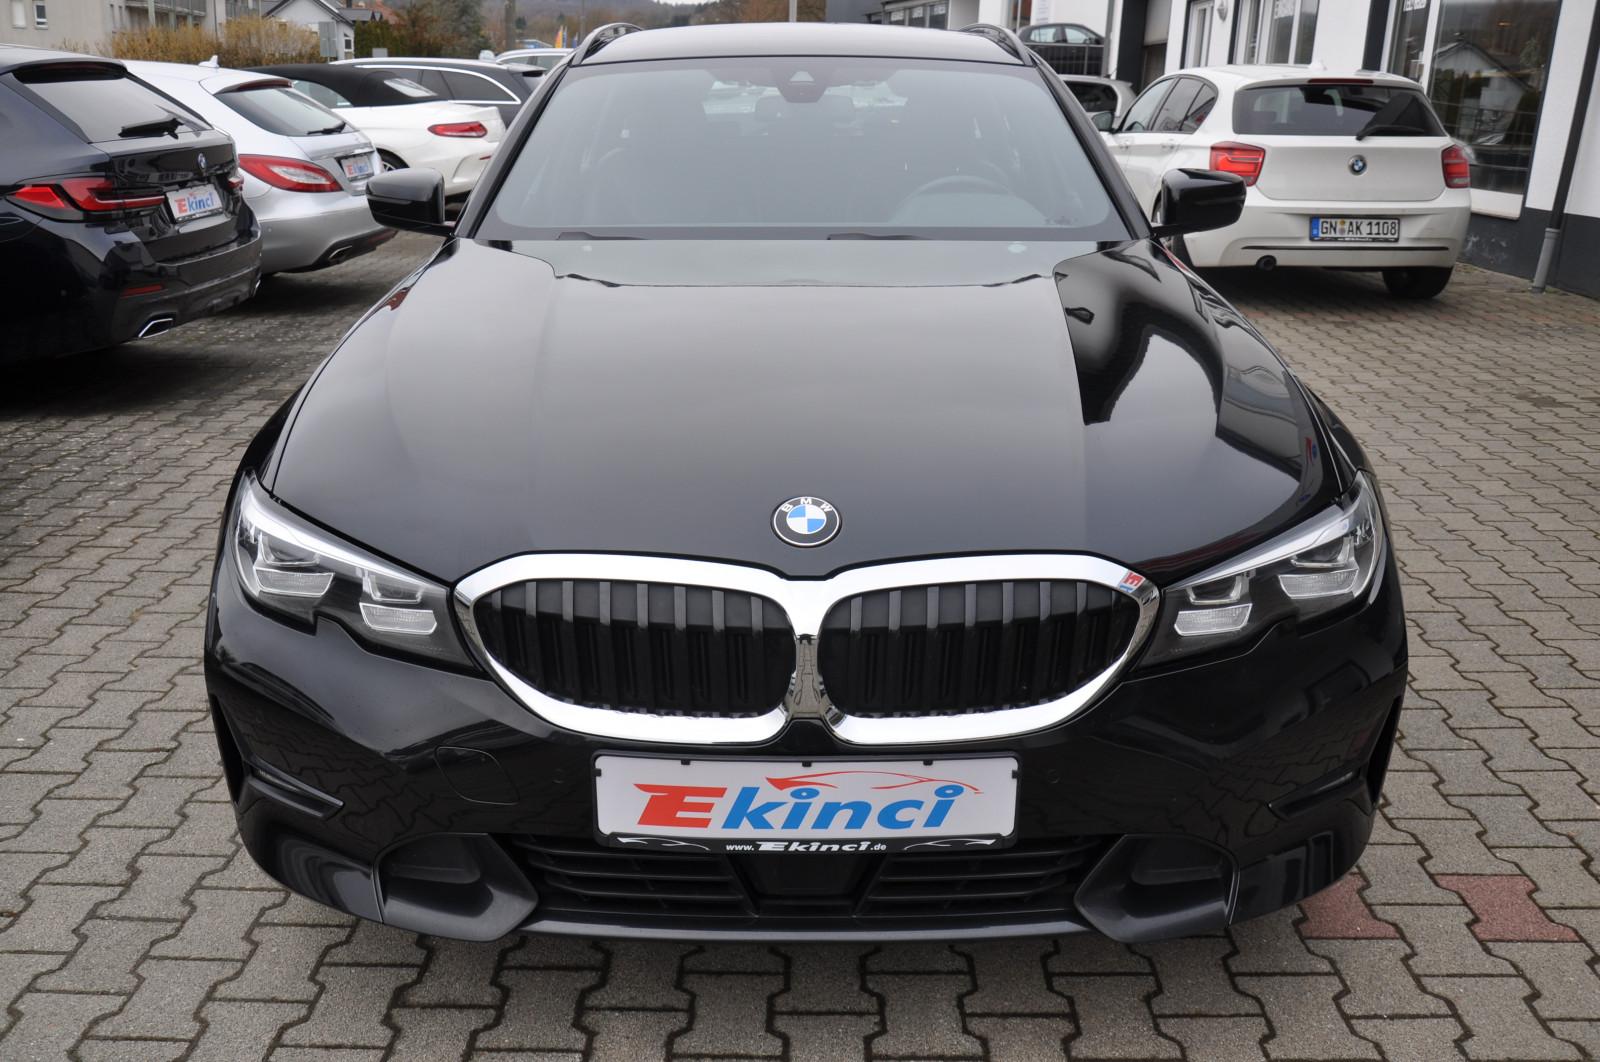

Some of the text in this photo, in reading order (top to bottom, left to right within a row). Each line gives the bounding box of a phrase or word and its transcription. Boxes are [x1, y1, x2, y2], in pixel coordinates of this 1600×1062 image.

[1321, 220, 1397, 236] GN AK 1108
[780, 497, 833, 513] BMW
[633, 784, 965, 830] Ekinci
